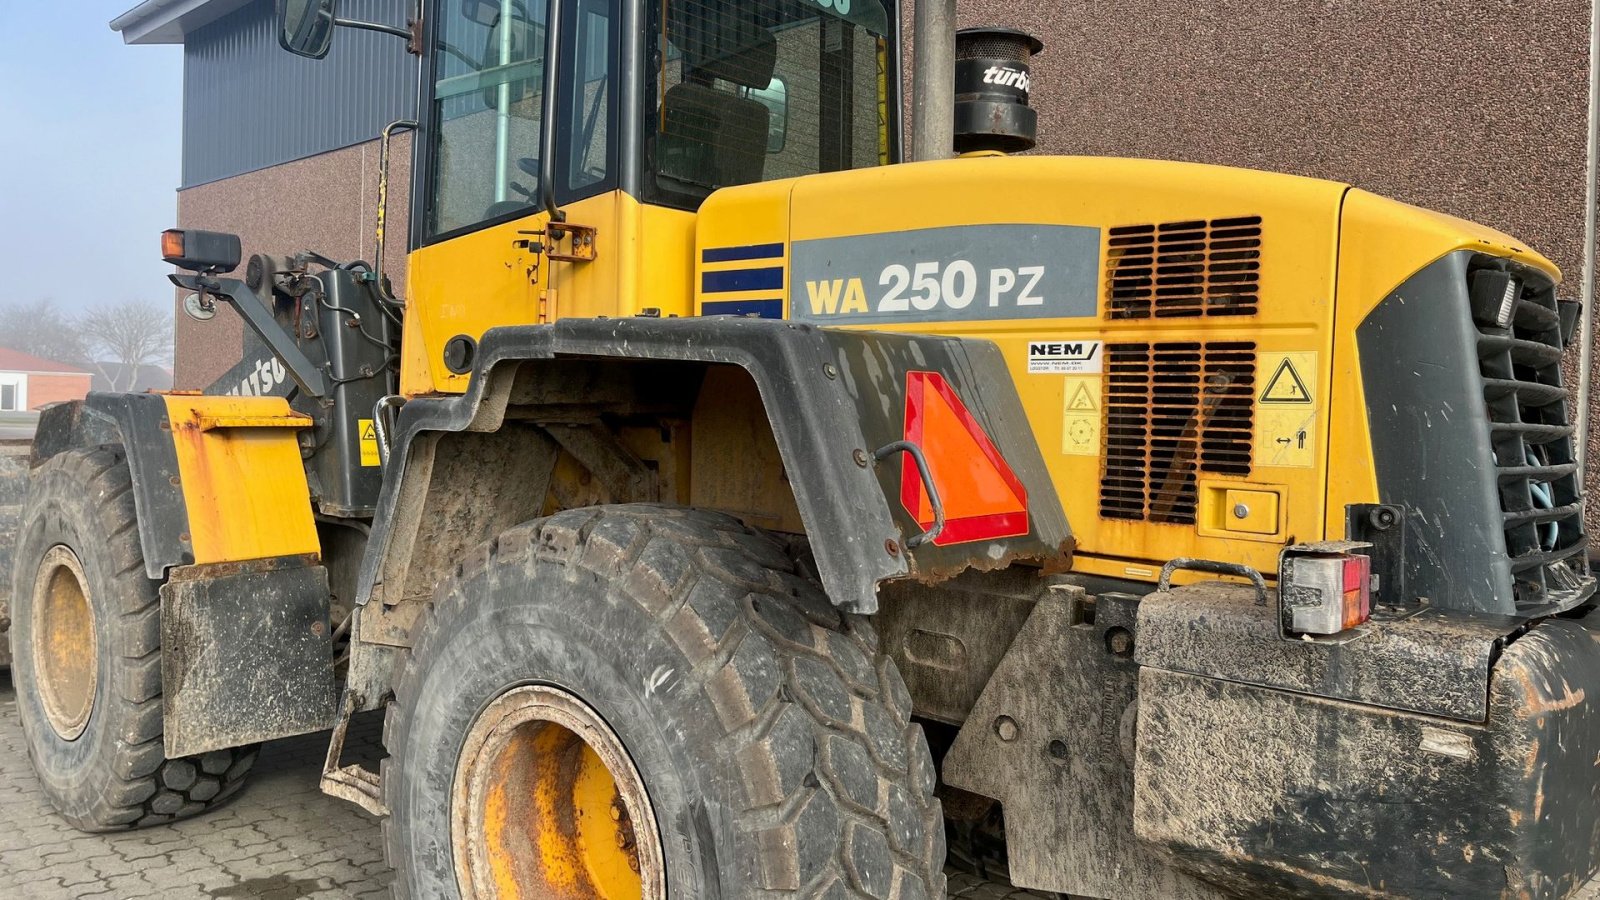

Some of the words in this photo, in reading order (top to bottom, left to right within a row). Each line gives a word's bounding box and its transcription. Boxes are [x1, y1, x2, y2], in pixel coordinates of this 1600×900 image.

[806, 277, 868, 315] WA
[877, 259, 977, 312] 250
[989, 265, 1045, 307] PZ
[1030, 343, 1083, 355] NEM
